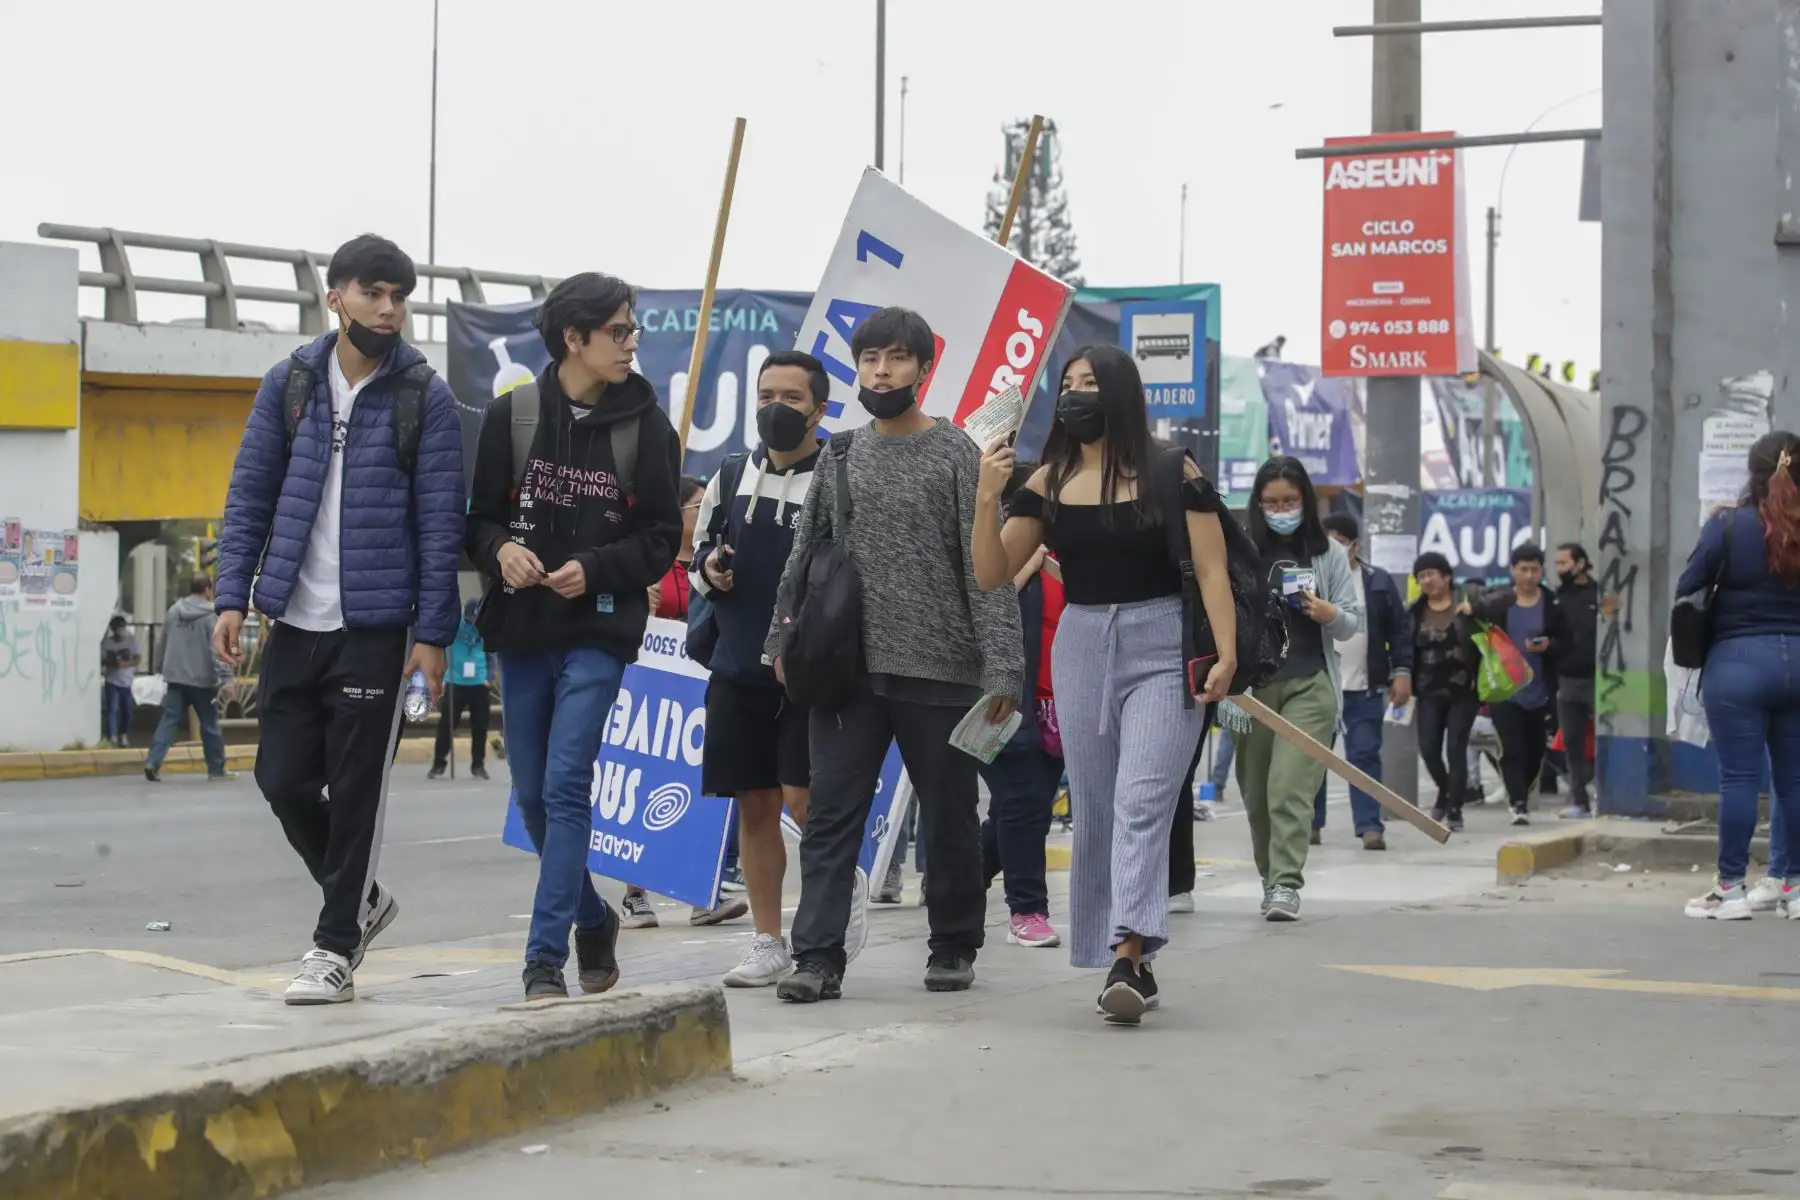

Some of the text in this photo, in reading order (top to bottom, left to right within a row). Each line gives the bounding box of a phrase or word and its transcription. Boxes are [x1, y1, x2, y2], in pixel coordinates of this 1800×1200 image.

[1361, 219, 1415, 236] CICLO
[856, 229, 904, 270] 1
[1331, 238, 1448, 258] SAN MARCOS
[634, 308, 779, 333] CADEMIA
[1349, 318, 1450, 336] 974 053 888
[984, 307, 1043, 404] ROS
[1144, 387, 1196, 405] RADERO
[557, 465, 618, 486] CHANGIN
[567, 480, 619, 501] THINGS
[1436, 494, 1515, 509] ACADEMIA
[644, 632, 678, 657] 5300
[590, 829, 645, 864] ACADE
